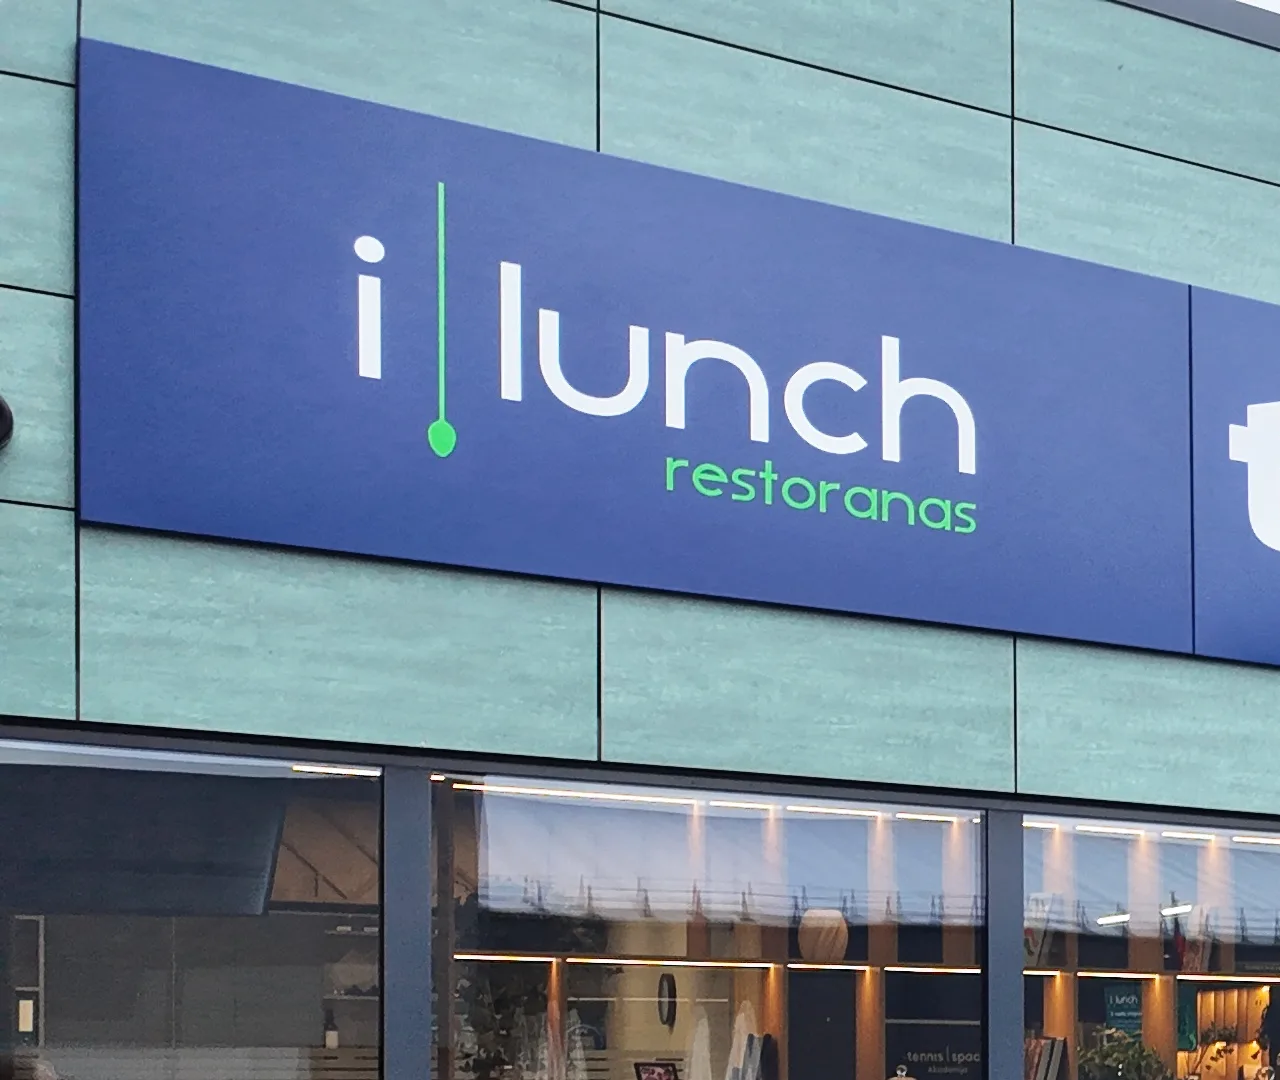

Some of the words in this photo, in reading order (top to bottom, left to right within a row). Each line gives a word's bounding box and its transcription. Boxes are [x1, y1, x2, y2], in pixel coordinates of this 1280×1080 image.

[353, 235, 385, 380] i
[499, 261, 977, 475] lunch
[665, 456, 977, 534] restoranas
[906, 1051, 944, 1062] tennis
[951, 1052, 981, 1064] spac
